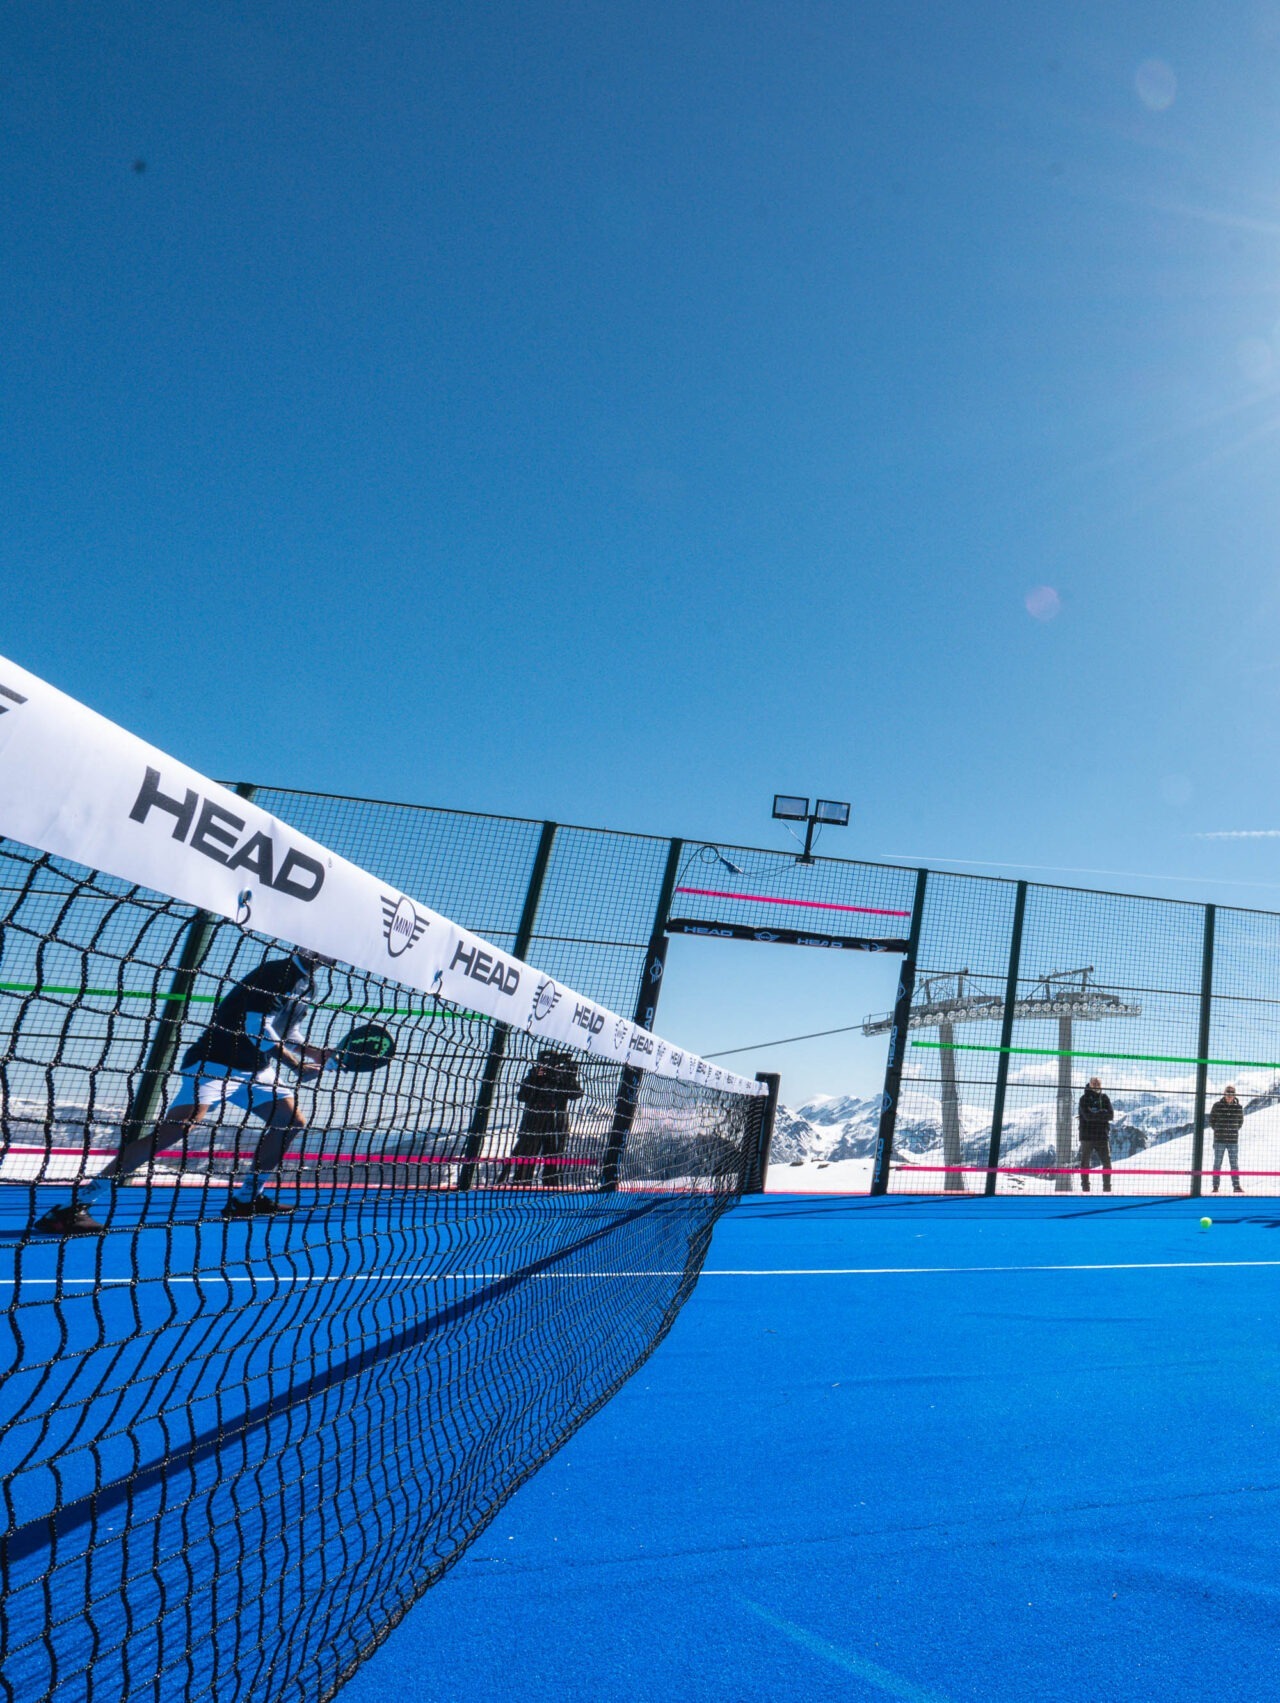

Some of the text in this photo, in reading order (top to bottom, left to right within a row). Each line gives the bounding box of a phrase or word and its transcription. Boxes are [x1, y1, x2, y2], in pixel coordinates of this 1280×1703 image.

[129, 765, 325, 902] HEAD
[393, 915, 413, 938] MINI
[684, 925, 733, 937] HEAD
[797, 937, 843, 949] HEAD
[449, 940, 520, 997] HEAD
[572, 1003, 604, 1035] HEAD
[629, 1032, 654, 1055] HEAD
[888, 1025, 898, 1067] HEAD
[874, 1138, 884, 1183] HEAD
